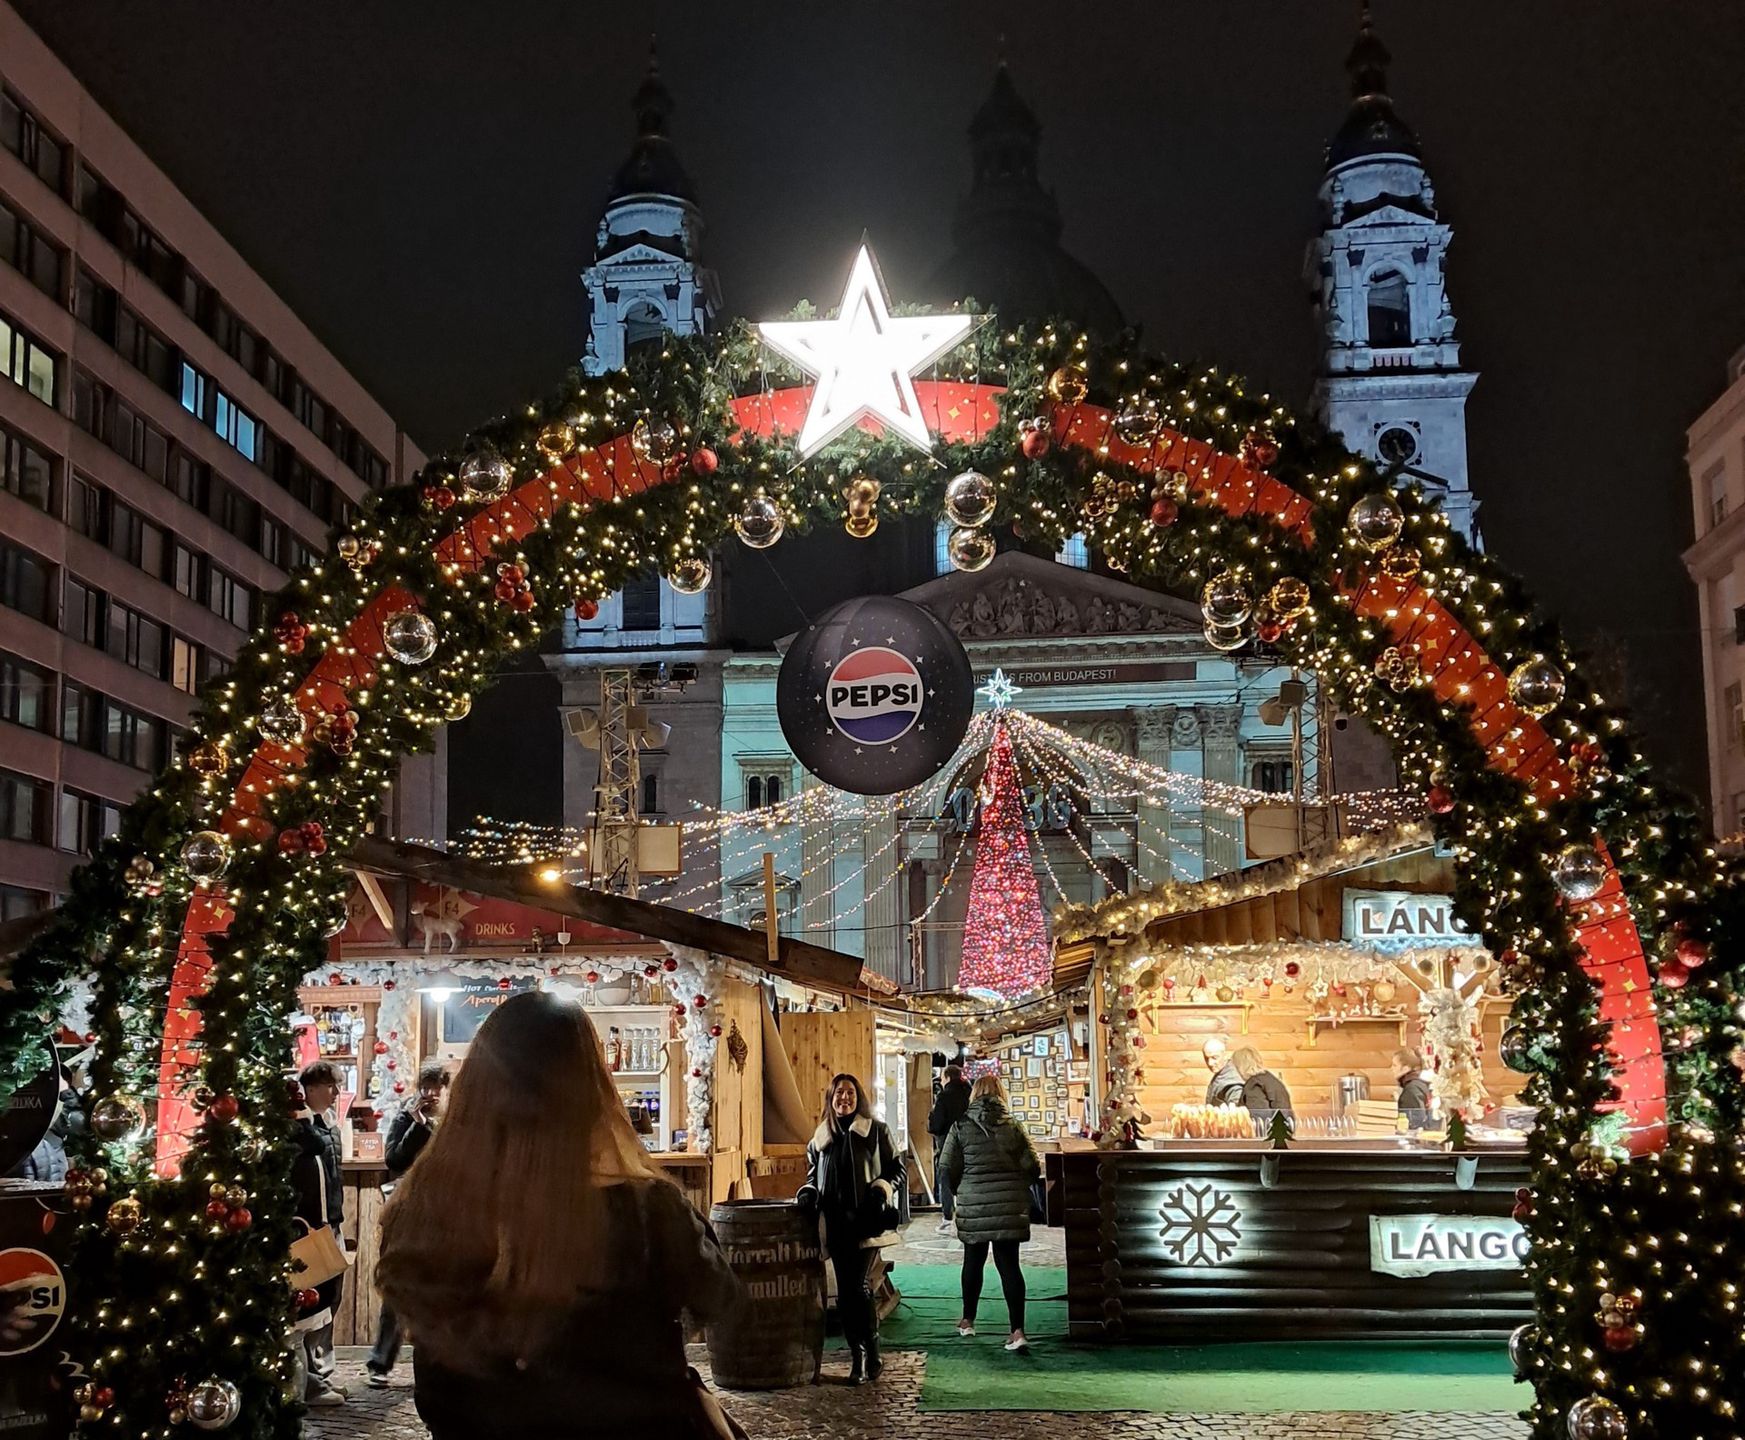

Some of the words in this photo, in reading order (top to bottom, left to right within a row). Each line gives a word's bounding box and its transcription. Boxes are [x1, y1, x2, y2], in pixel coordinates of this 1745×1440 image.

[1018, 671, 1052, 684] FROM
[1054, 669, 1117, 682] BUDAPEST!
[831, 683, 918, 708] PEPSI
[444, 902, 460, 915] F4
[475, 923, 516, 936] DRINKS
[747, 1273, 808, 1299] mulled
